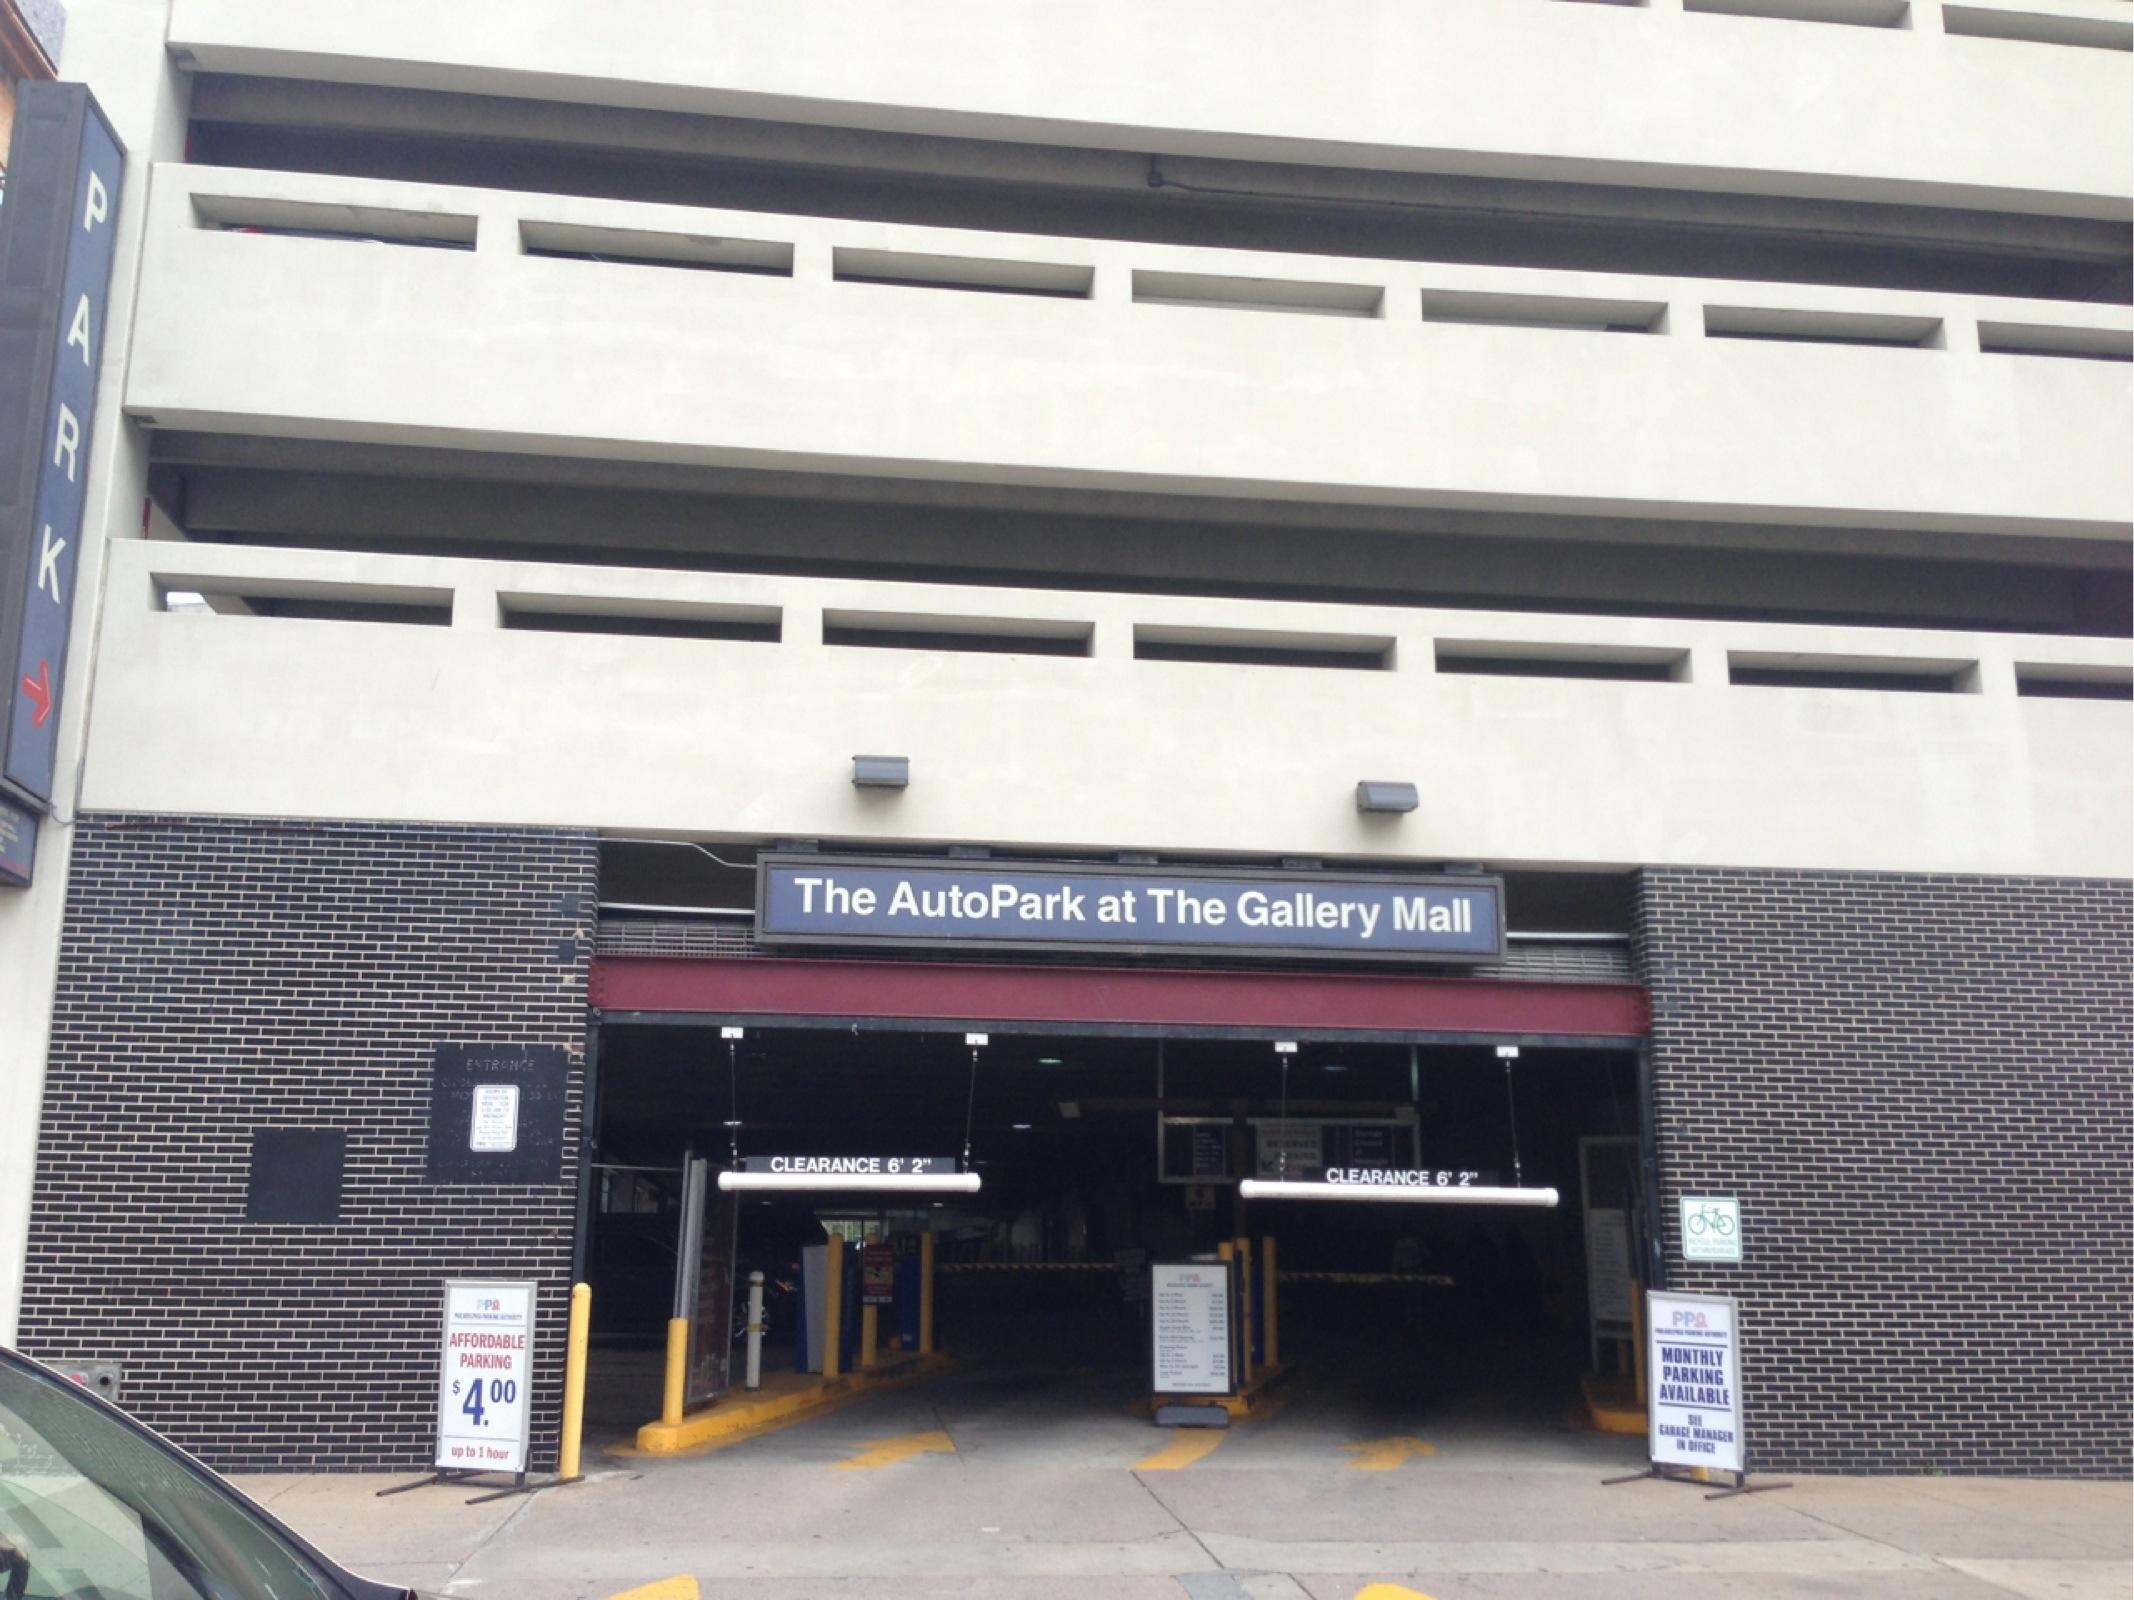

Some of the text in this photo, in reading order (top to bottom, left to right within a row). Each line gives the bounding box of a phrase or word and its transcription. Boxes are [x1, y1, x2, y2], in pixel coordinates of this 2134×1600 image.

[37, 169, 107, 604] PARK
[794, 877, 1472, 939] The AutoPark at The Gallery Mall
[771, 1156, 881, 1173] CLEARANCE
[887, 1157, 904, 1173] 6'
[1326, 1167, 1430, 1186] CLEARANCE
[1436, 1171, 1453, 1186] 6'
[449, 1332, 526, 1350] AFFORDABLE
[459, 1353, 513, 1370] PARKING
[1661, 1347, 1724, 1367] MONTHLY
[1662, 1365, 1724, 1385] PARKING
[1659, 1383, 1731, 1406] AVAILABLE
[1692, 1427, 1734, 1443] MANAGER
[451, 1446, 464, 1458] up
[466, 1446, 476, 1458] to
[486, 1446, 510, 1460] hour
[1676, 1439, 1716, 1454] IN OFFICE
